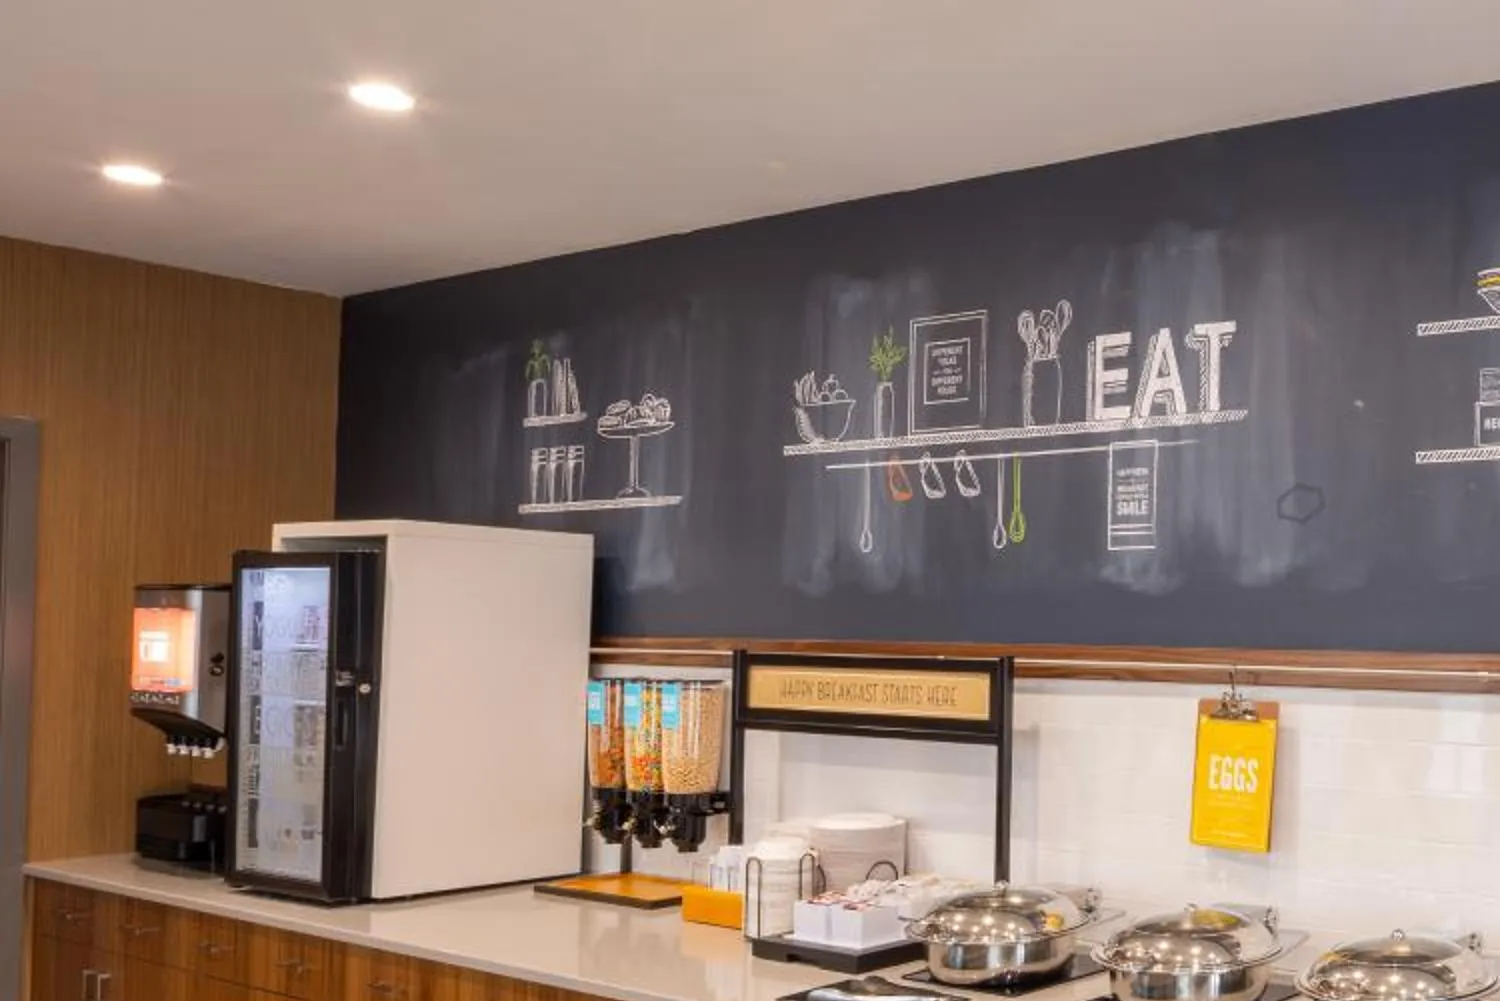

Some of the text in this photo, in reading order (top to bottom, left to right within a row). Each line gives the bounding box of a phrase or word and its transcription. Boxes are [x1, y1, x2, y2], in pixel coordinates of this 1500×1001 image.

[1087, 320, 1237, 421] EAT
[1116, 500, 1149, 516] SMILE
[817, 680, 880, 703] BREAKFAST
[882, 683, 923, 705] STARTS
[927, 685, 957, 706] HERE
[1208, 753, 1260, 794] EGGS
